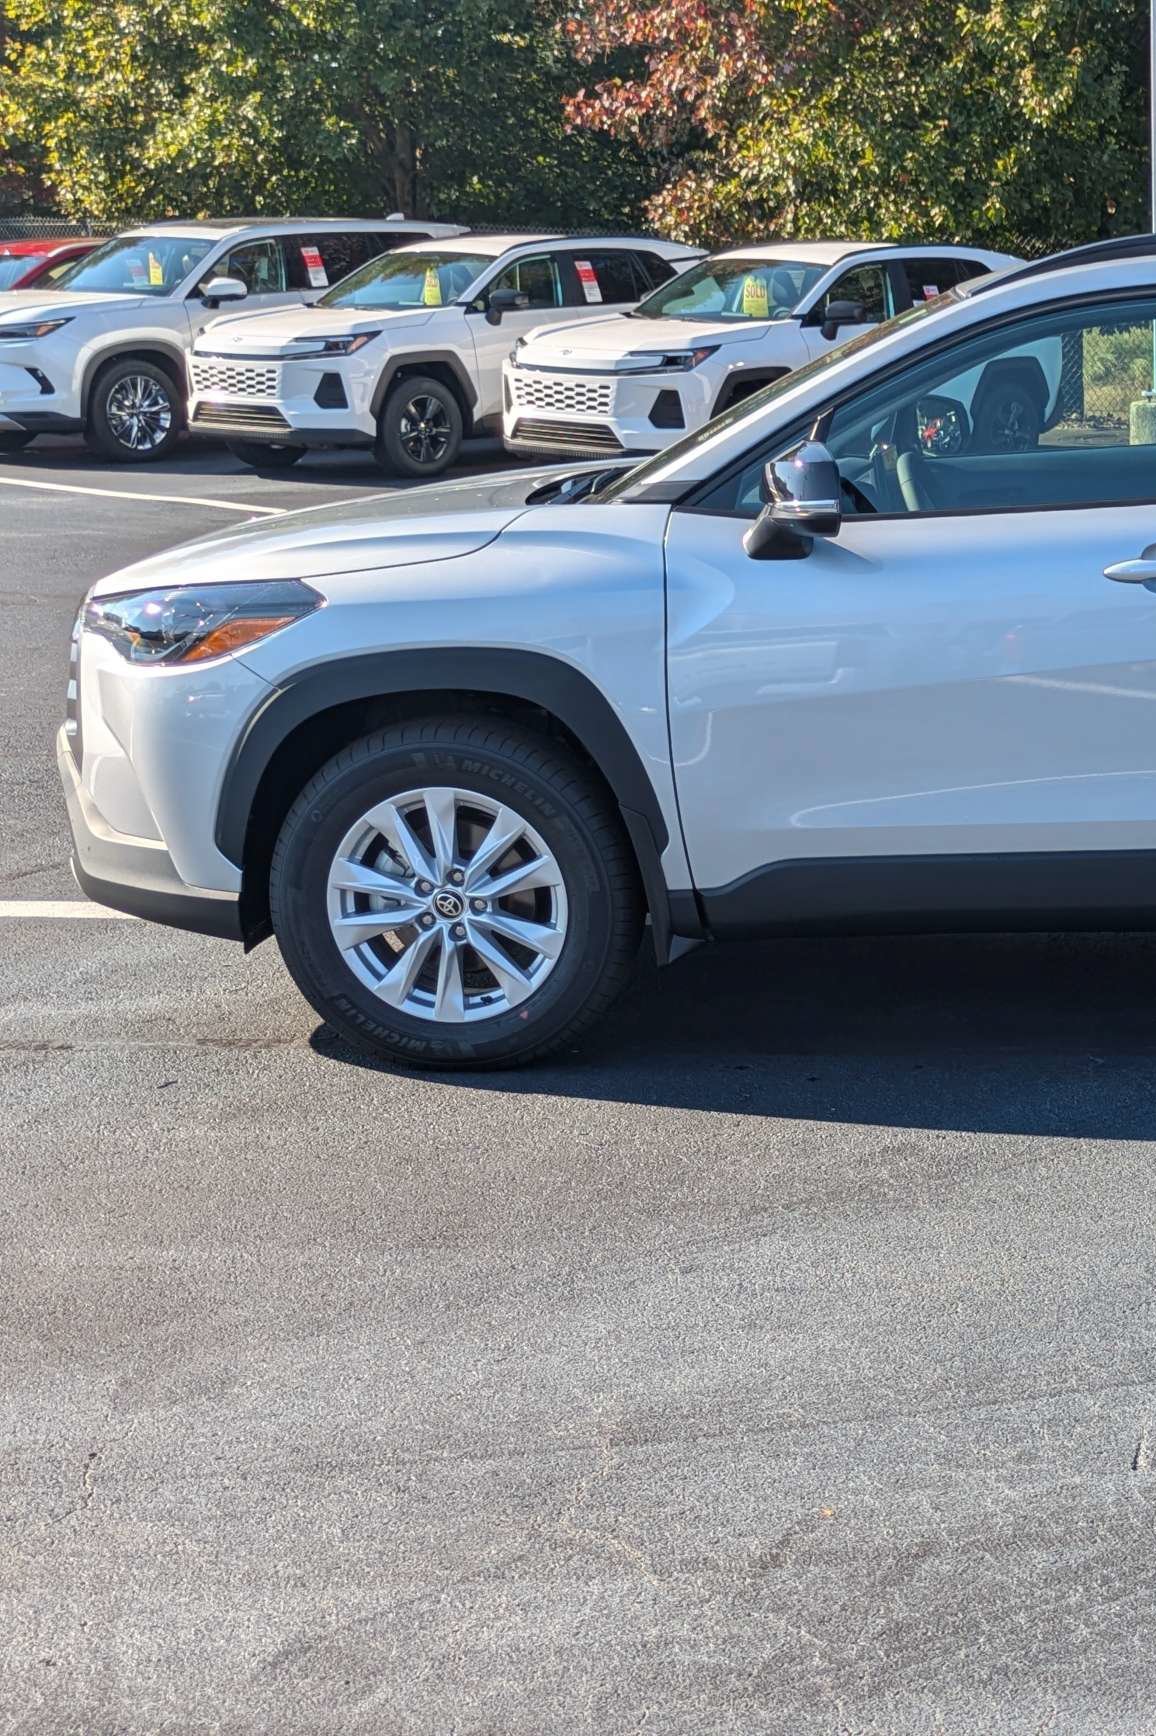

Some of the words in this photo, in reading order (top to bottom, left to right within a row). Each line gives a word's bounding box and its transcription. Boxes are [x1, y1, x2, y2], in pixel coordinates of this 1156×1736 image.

[745, 284, 766, 298] SOLD
[462, 759, 557, 816] MICHELIN
[335, 997, 428, 1051] MICHELIN
